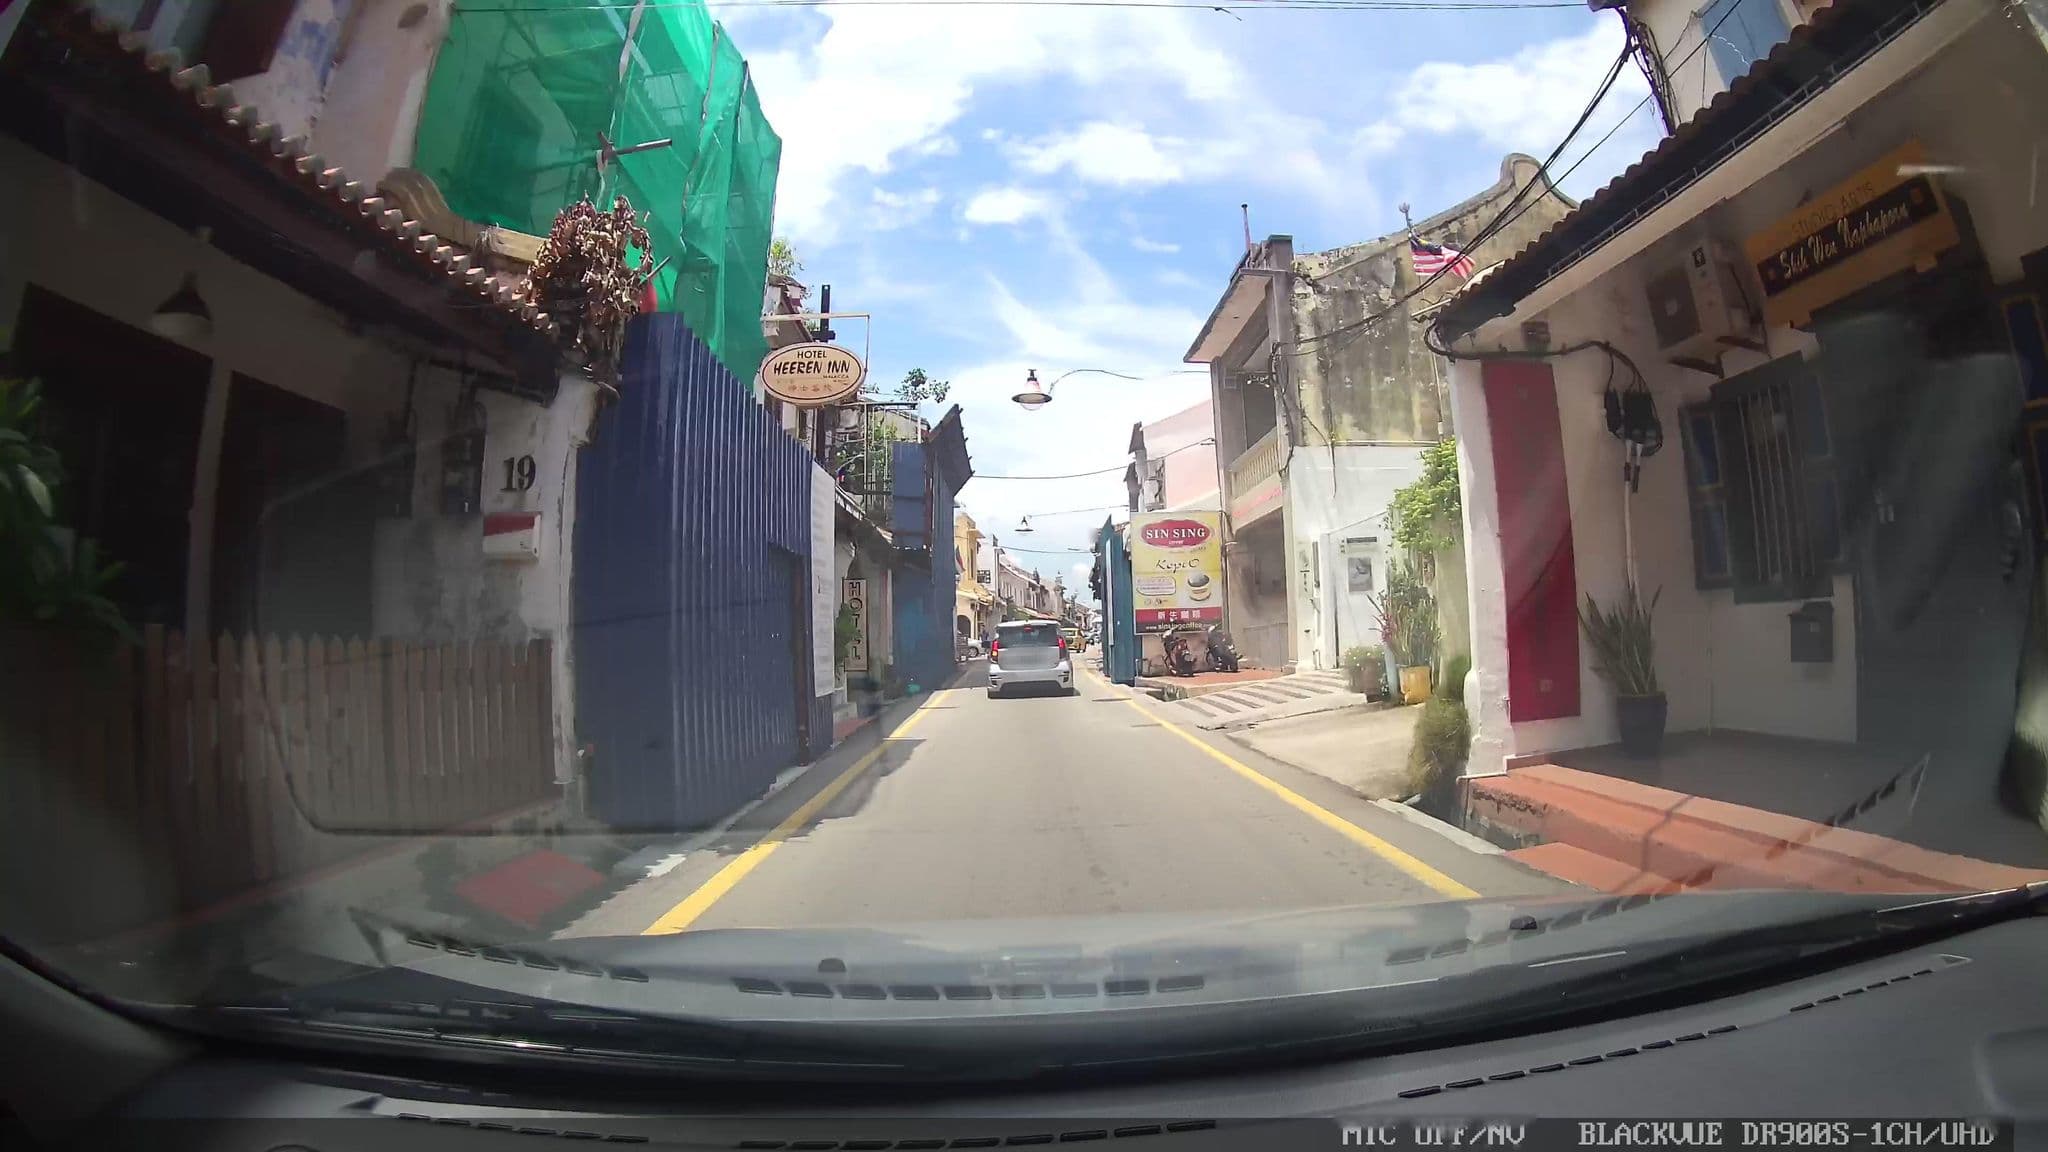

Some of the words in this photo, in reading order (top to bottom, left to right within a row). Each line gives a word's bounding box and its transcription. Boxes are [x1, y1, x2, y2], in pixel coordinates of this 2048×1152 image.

[797, 350, 827, 359] HOTEL
[774, 361, 822, 376] HEEREN
[827, 360, 851, 374] INN
[500, 455, 536, 491] 19
[1146, 529, 1169, 539] SIN
[1173, 528, 1205, 538] SING
